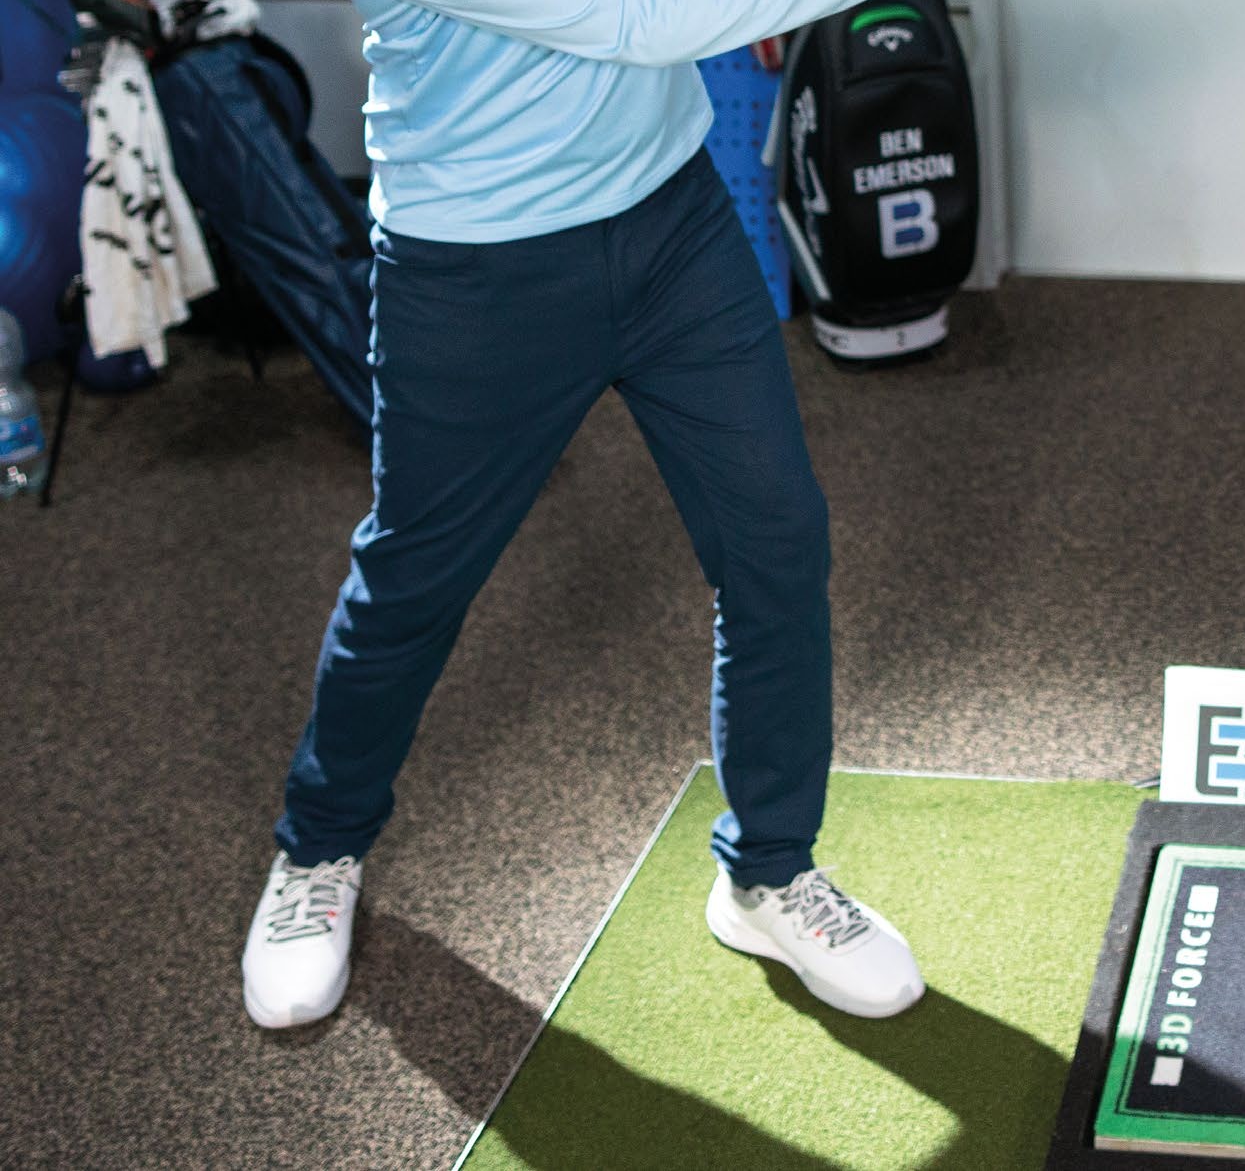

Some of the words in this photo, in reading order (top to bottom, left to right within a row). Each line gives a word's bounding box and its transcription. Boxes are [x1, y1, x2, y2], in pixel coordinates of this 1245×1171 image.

[880, 128, 922, 158] BEN
[854, 152, 956, 194] EMERSON
[1166, 911, 1216, 1008] FORCE
